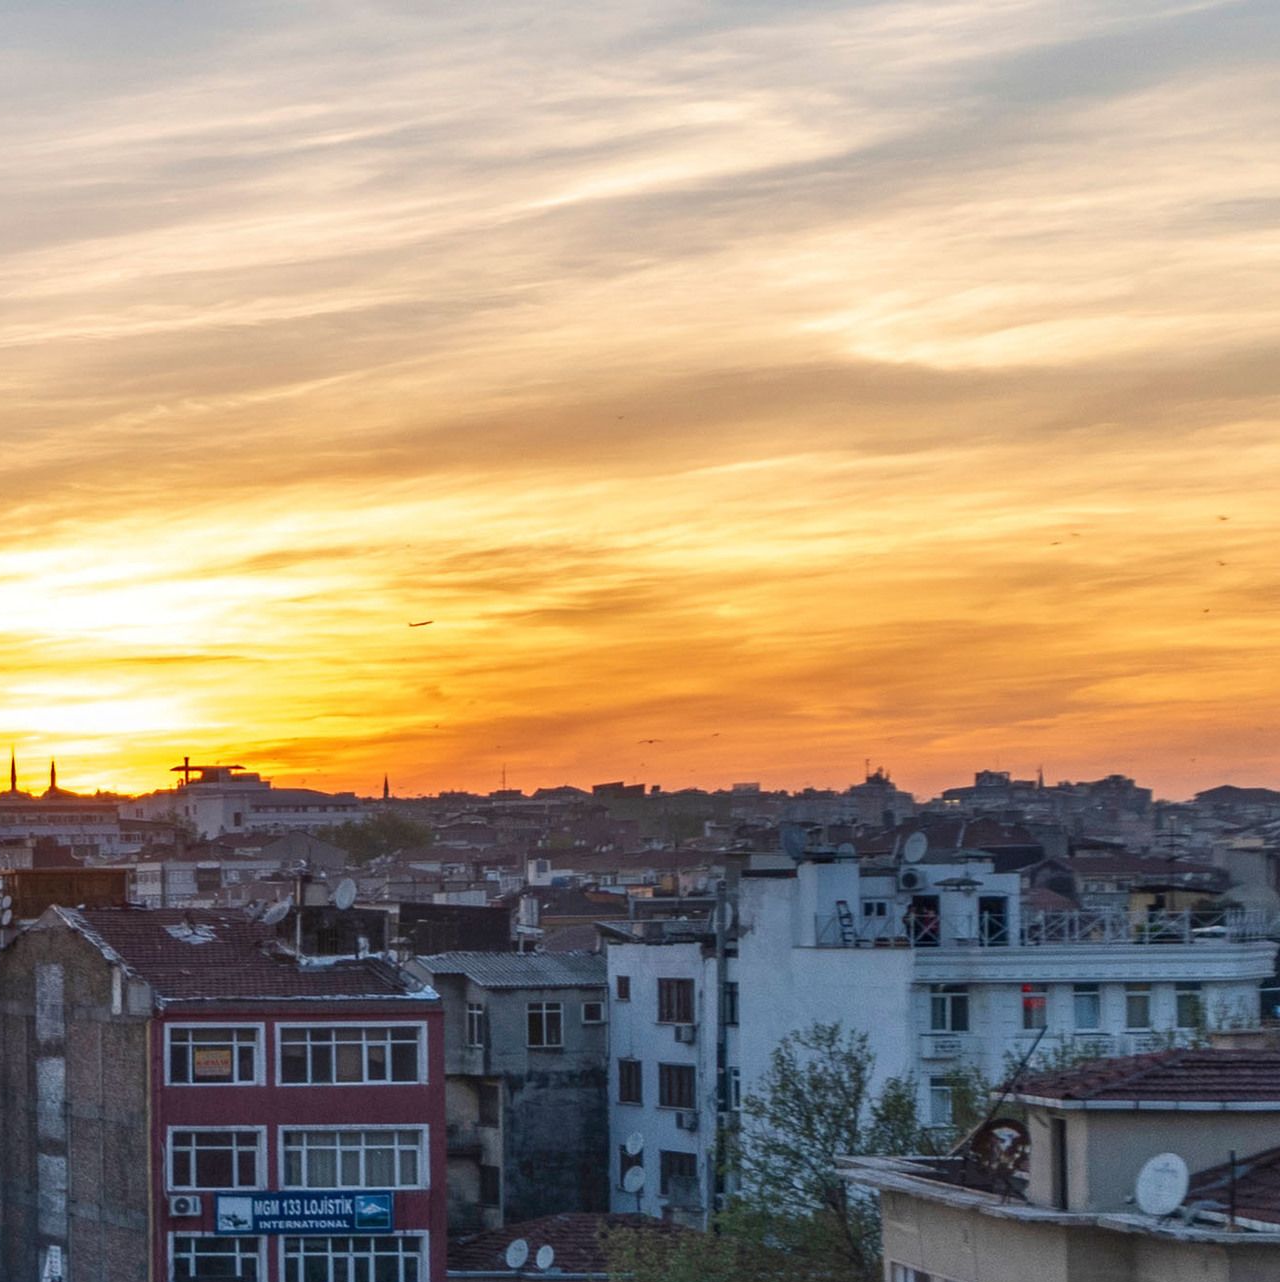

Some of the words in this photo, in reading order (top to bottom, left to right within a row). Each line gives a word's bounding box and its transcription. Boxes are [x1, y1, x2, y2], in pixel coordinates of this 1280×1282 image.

[254, 1200, 281, 1216] MGM
[283, 1200, 303, 1216] 133
[304, 1195, 354, 1216] LOJİSTİK
[259, 1219, 351, 1230] INTERNATIONAL
